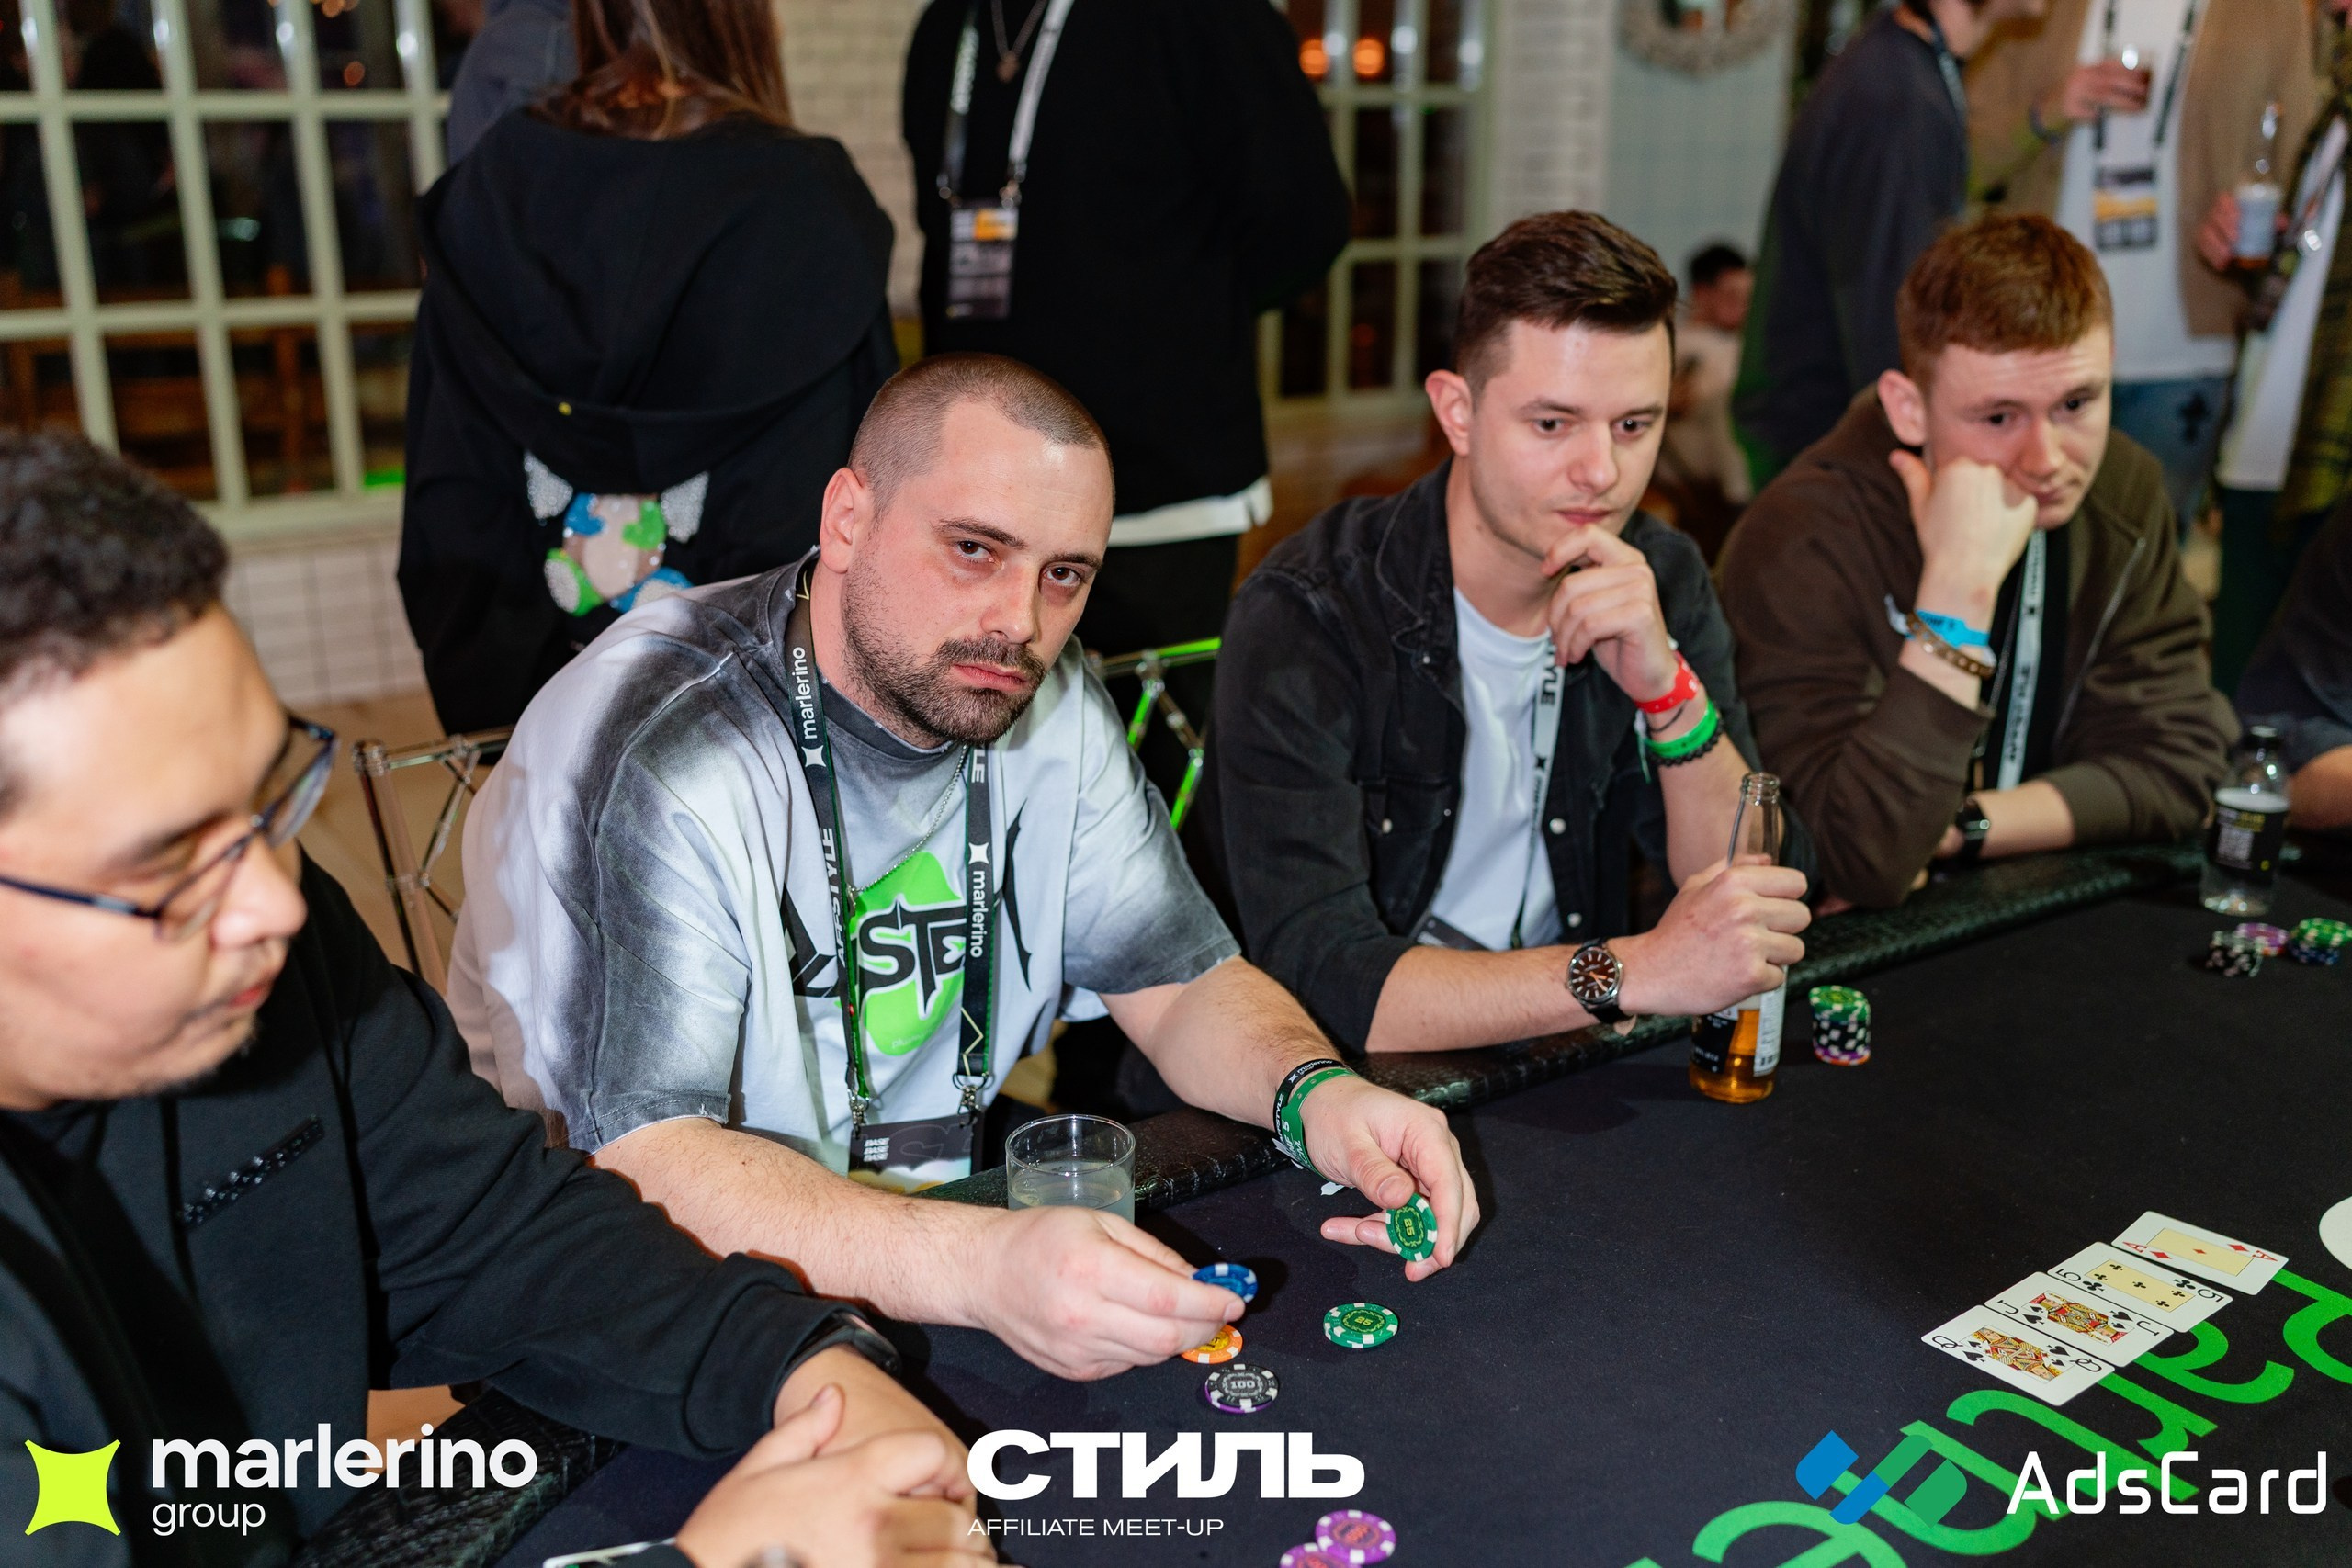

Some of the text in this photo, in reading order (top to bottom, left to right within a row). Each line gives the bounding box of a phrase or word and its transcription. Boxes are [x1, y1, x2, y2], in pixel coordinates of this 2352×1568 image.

[791, 646, 818, 740] marlerino
[969, 869, 989, 960] marlerino
[1403, 1218, 1416, 1237] 25
[2121, 1240, 2149, 1254] A
[2250, 1249, 2278, 1262] A
[2054, 1269, 2083, 1282] 5
[2196, 1288, 2224, 1303] 5
[1996, 1298, 2020, 1315] J
[1354, 1316, 1372, 1327] 25
[2135, 1319, 2160, 1337] J
[1931, 1335, 1961, 1349] Q
[2075, 1358, 2104, 1372] Q
[1230, 1381, 1256, 1389] 100
